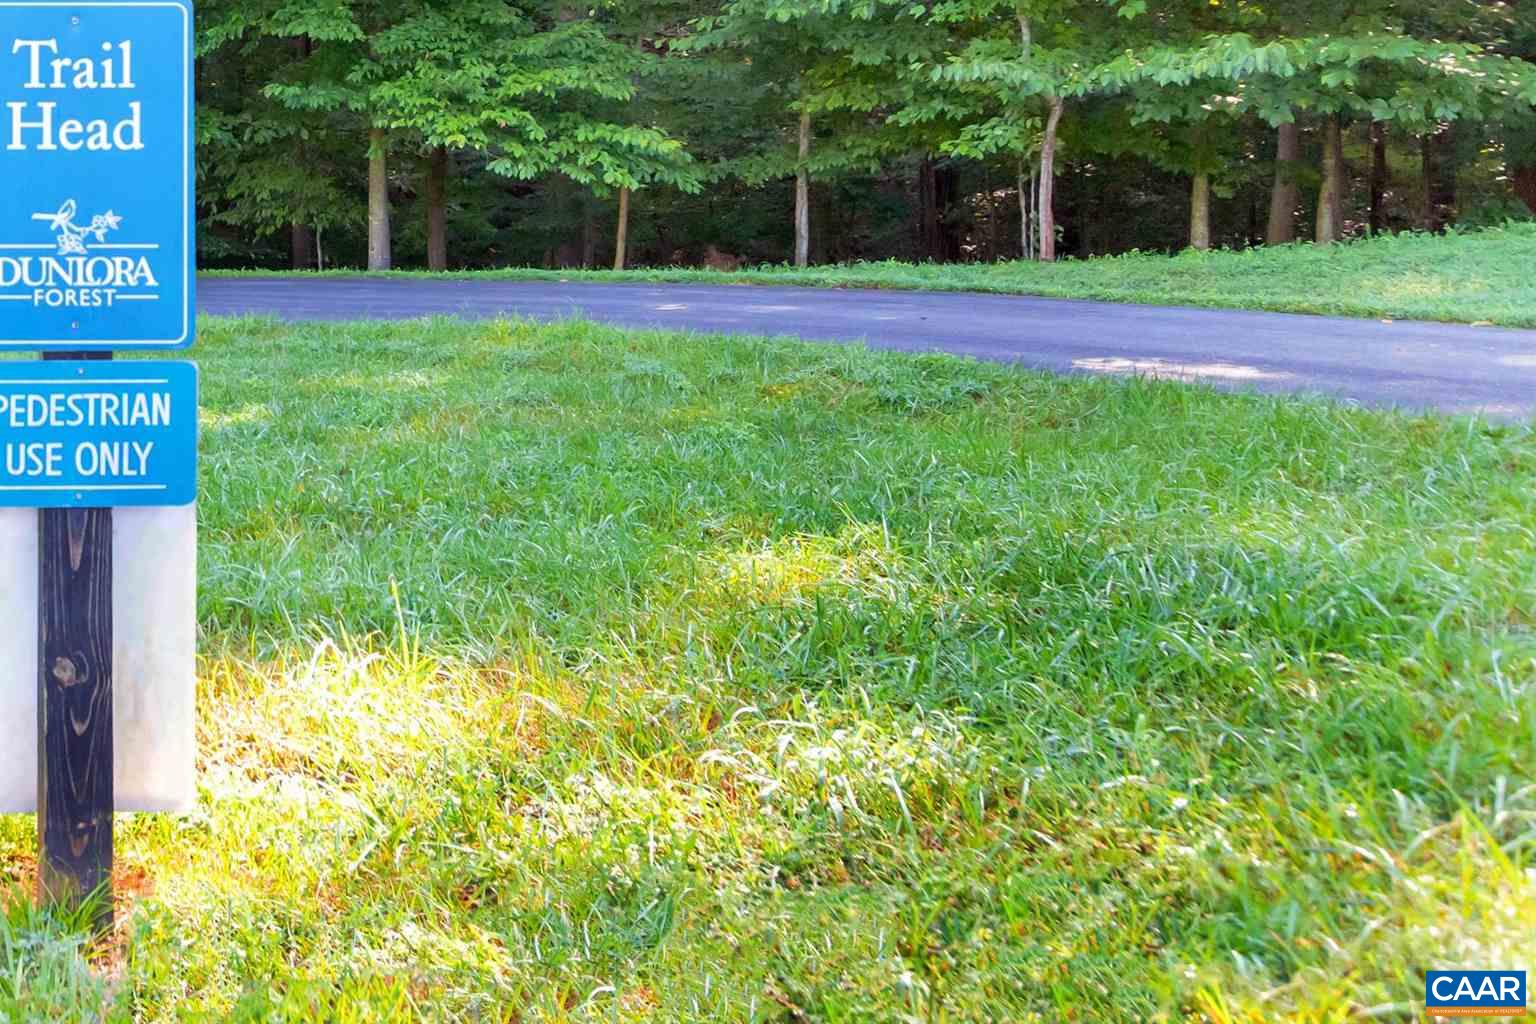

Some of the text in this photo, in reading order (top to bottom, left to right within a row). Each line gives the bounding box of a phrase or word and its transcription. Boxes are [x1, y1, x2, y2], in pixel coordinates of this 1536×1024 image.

[13, 39, 135, 89] Trail
[7, 102, 145, 151] Head
[33, 288, 116, 306] FOREST
[6, 442, 153, 476] USE ONLY
